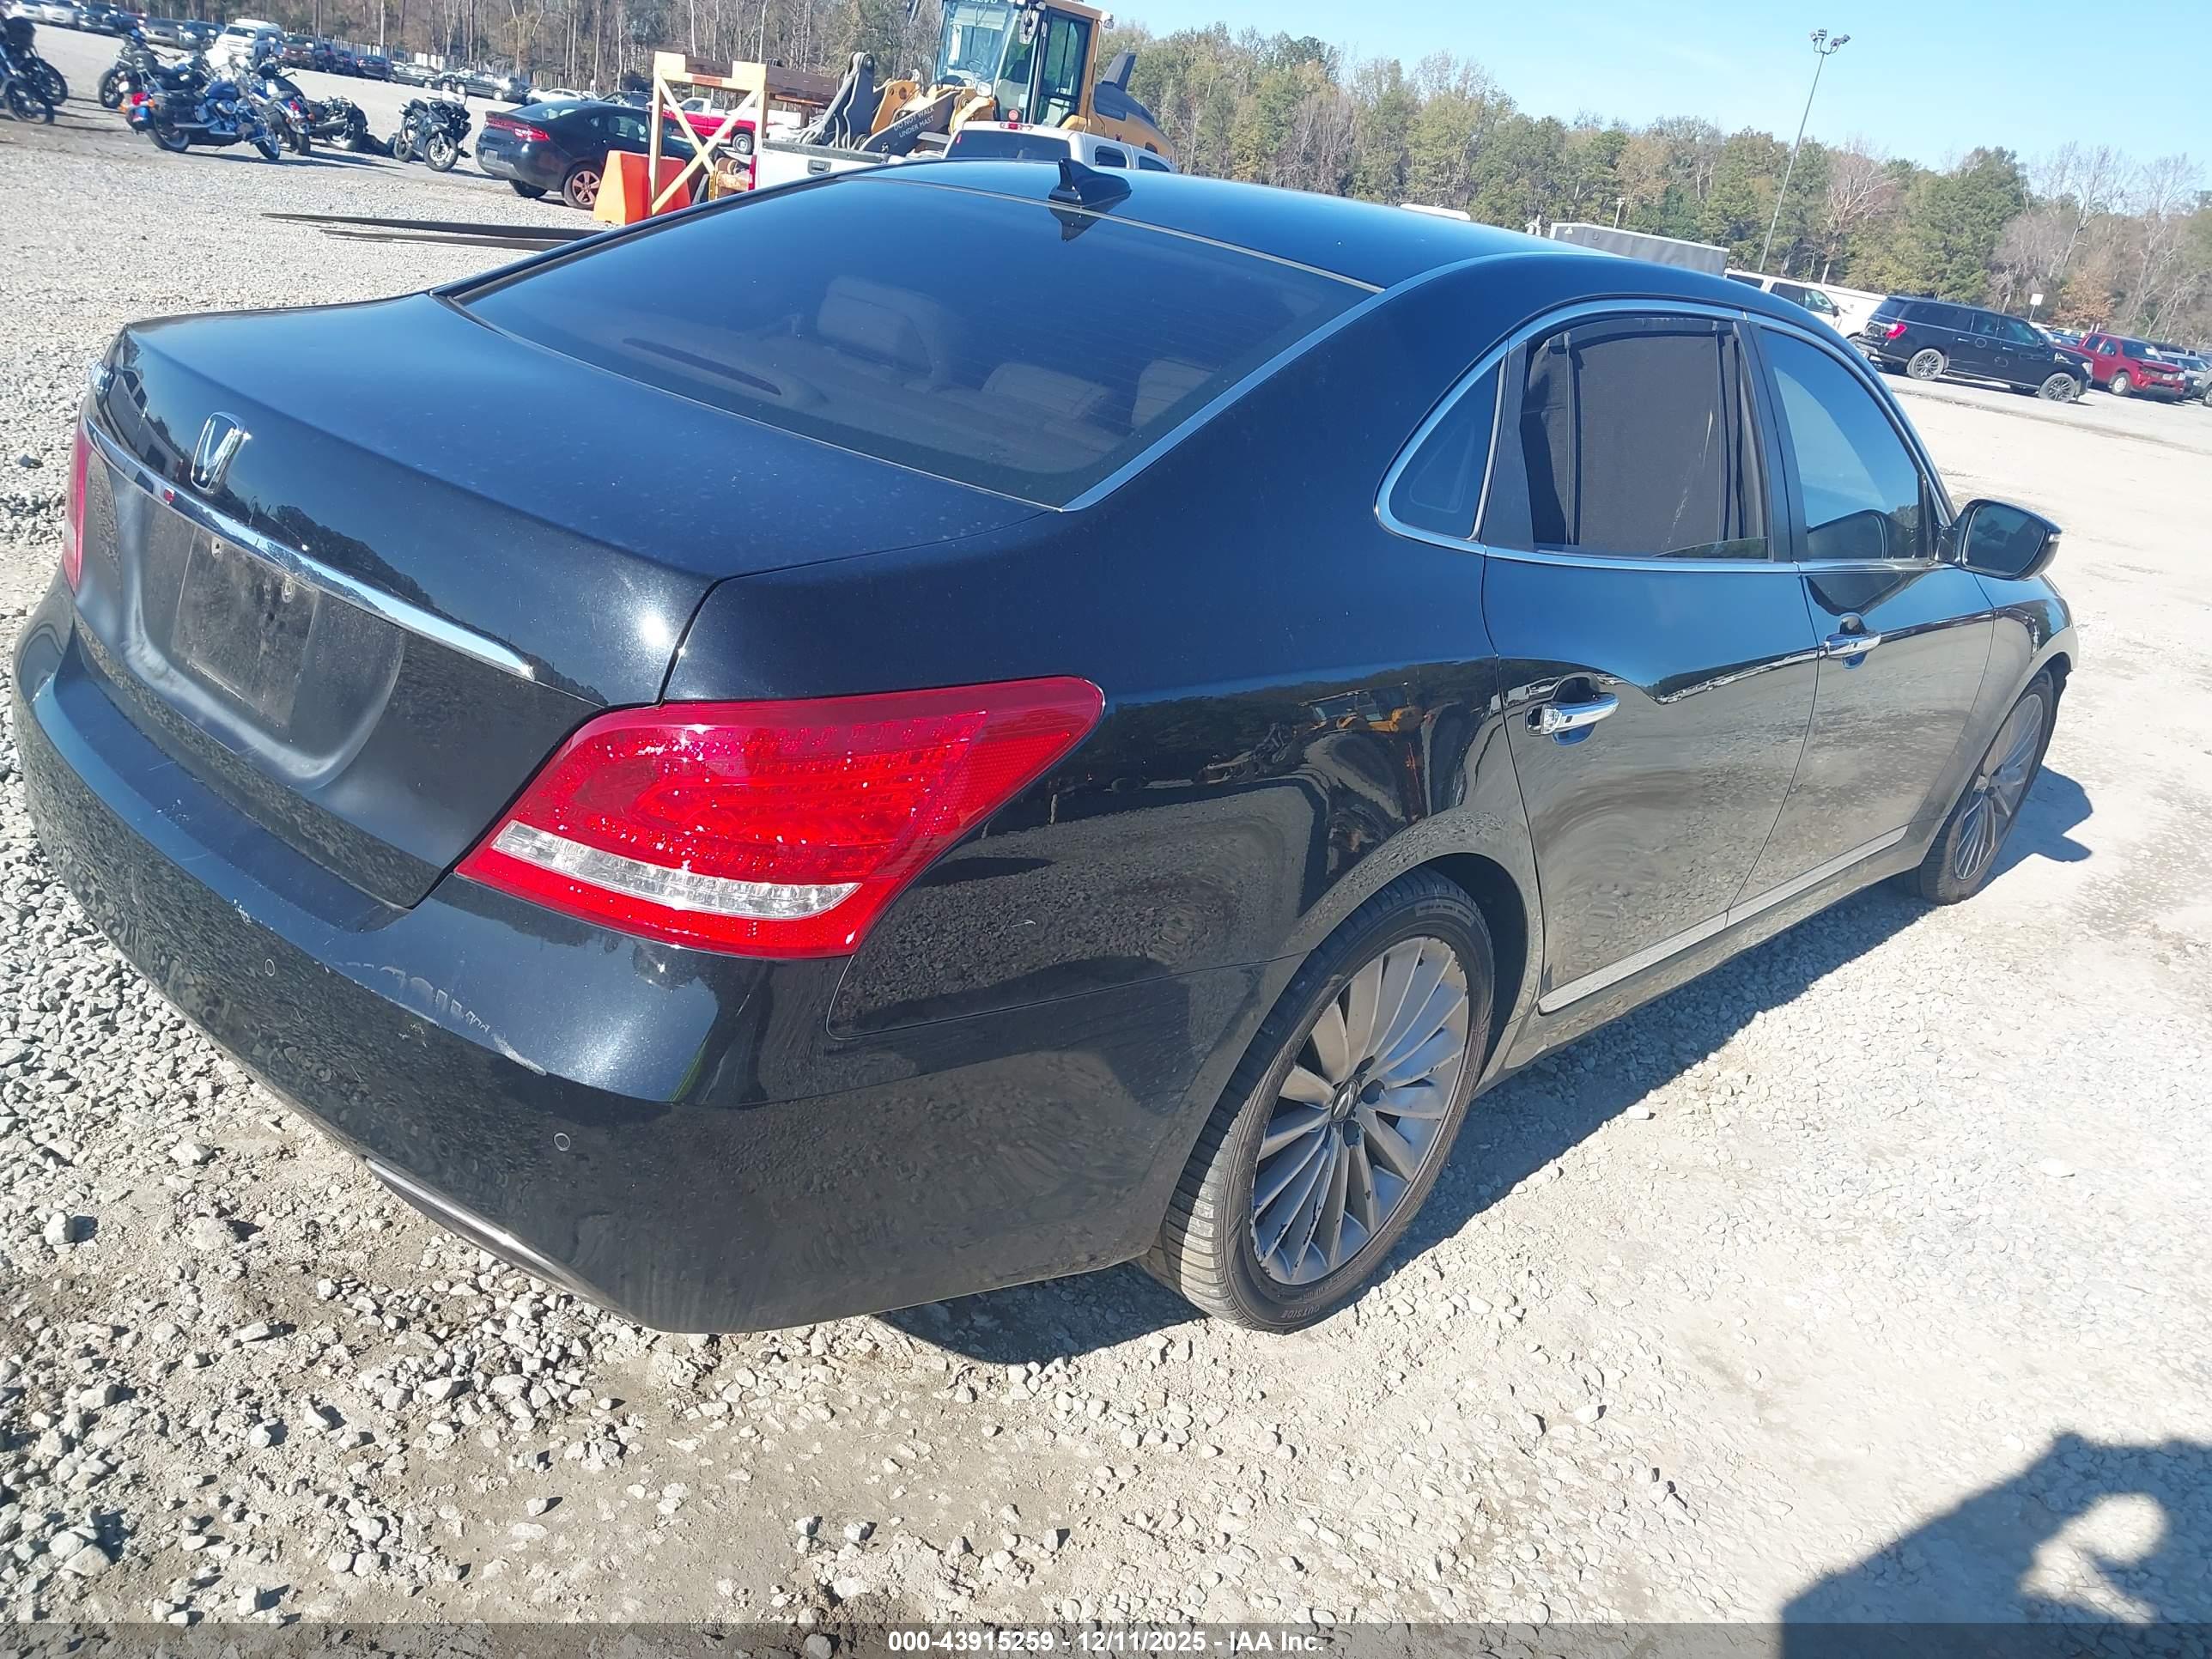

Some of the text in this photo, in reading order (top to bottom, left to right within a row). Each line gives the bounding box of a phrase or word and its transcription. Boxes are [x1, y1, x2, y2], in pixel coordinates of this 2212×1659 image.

[894, 106, 935, 131] DO NOT WALK
[899, 115, 934, 137] UNDER MAST
[1280, 1305, 1320, 1319] OUTSIDE
